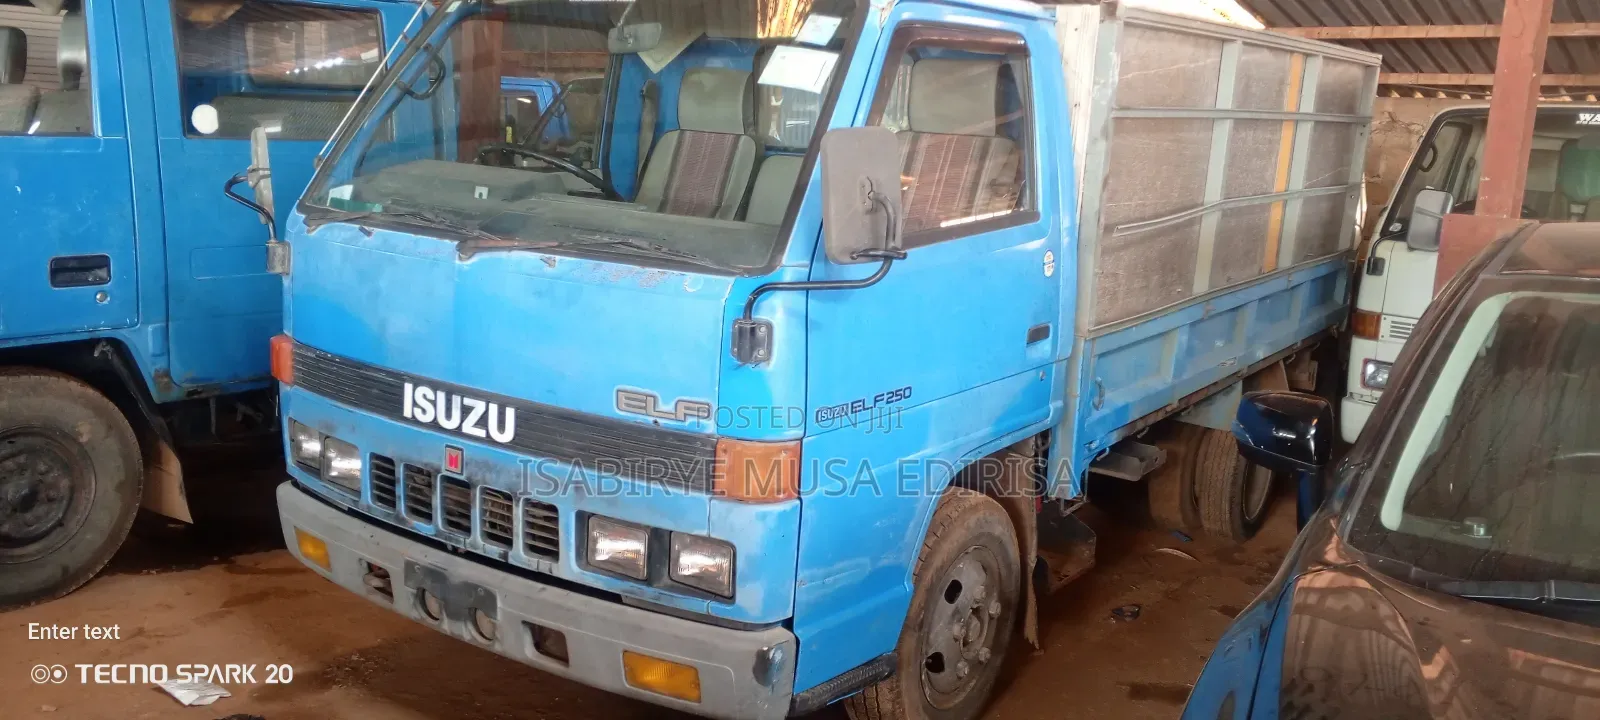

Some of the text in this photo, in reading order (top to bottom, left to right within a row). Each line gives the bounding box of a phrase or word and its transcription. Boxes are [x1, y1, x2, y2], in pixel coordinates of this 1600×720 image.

[403, 382, 516, 443] ISUZU
[616, 389, 711, 422] ELF
[816, 403, 849, 423] ISUZU
